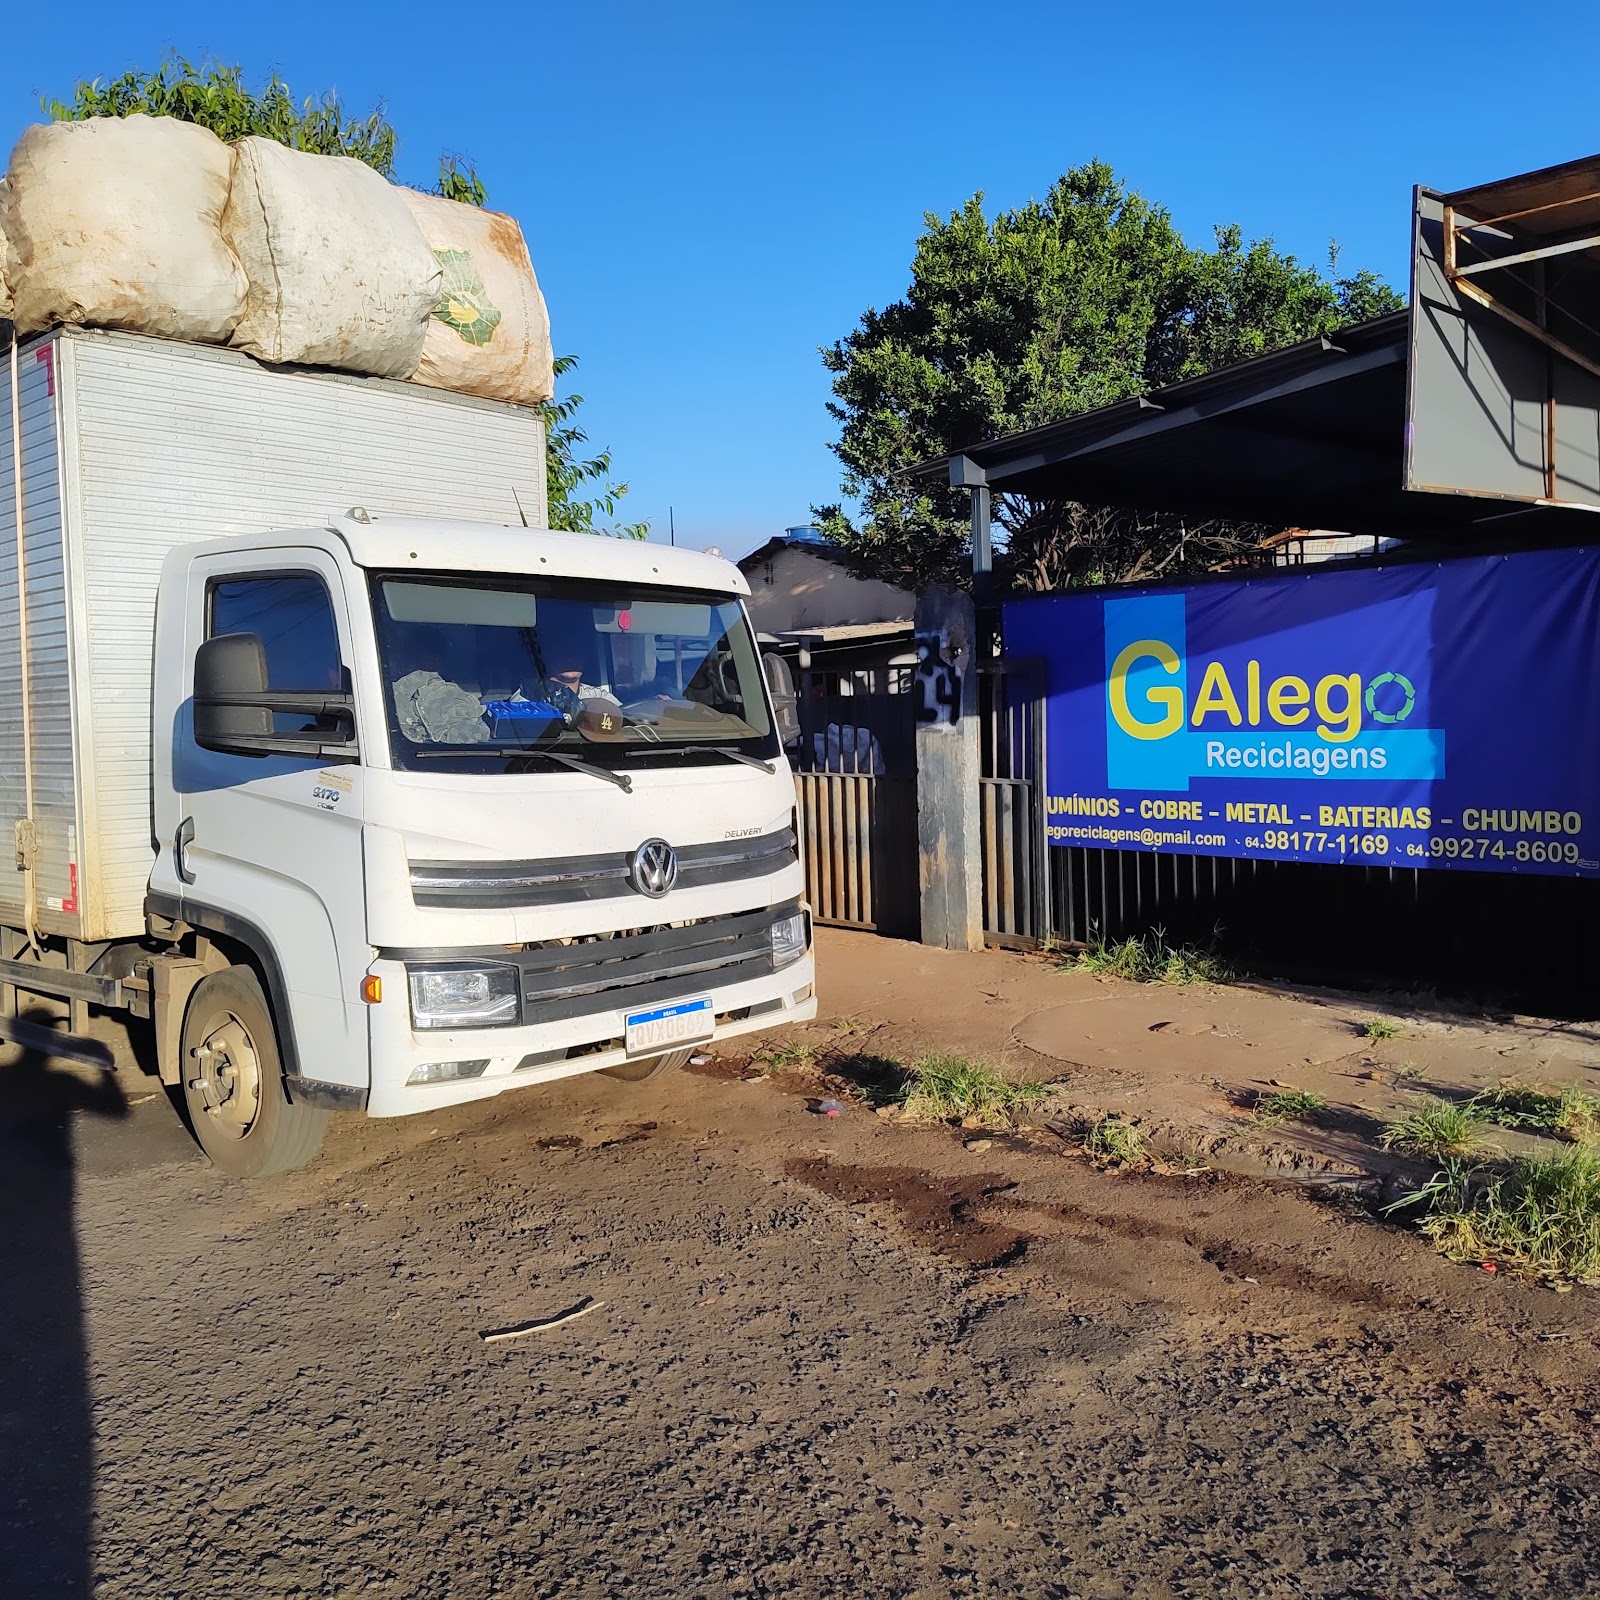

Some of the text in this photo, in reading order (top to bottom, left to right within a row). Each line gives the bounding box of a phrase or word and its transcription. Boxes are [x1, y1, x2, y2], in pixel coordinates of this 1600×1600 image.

[1206, 741, 1387, 776] Reciclagens
[724, 827, 763, 839] DELIVERY
[1140, 799, 1203, 821] COBRE
[1225, 802, 1293, 825] METAL
[1319, 805, 1431, 830] BATERIAS
[1462, 808, 1582, 835] CHUMBO
[1245, 830, 1389, 855] 64.98177-1169
[1406, 836, 1579, 864] 64.99274-8609
